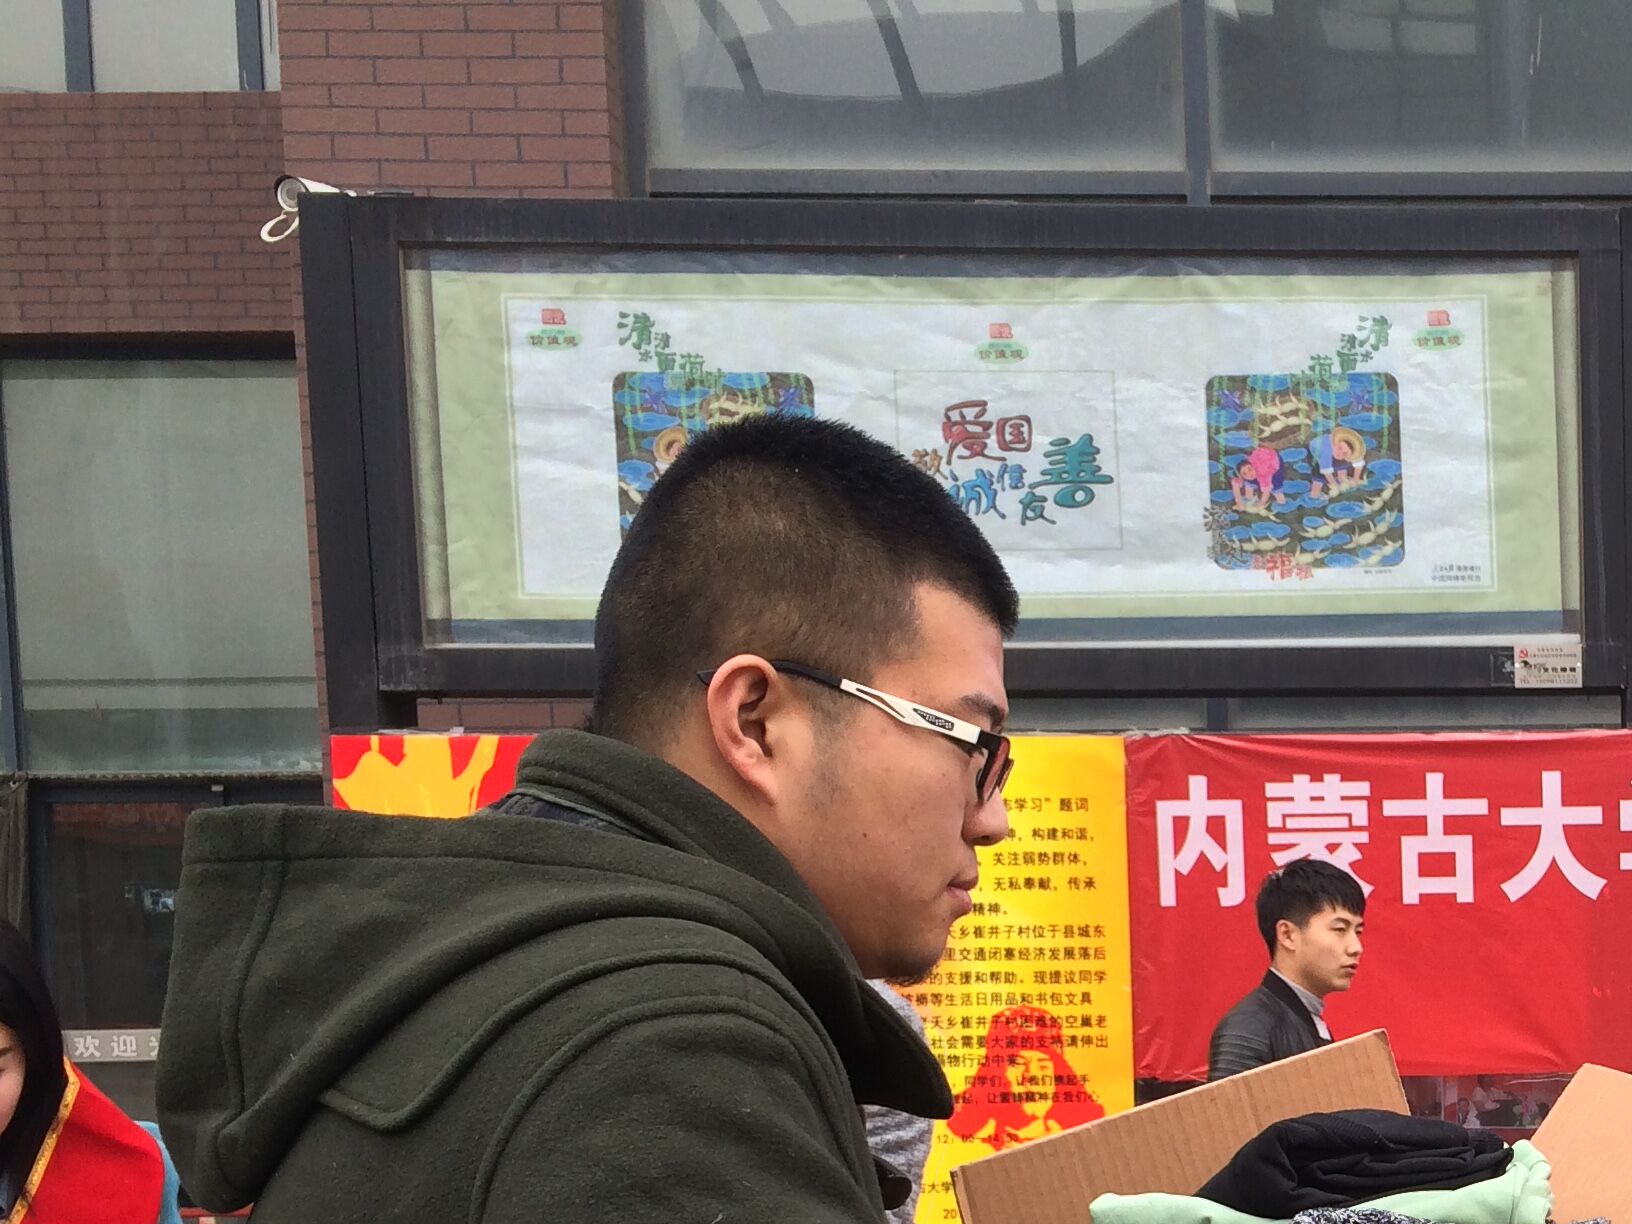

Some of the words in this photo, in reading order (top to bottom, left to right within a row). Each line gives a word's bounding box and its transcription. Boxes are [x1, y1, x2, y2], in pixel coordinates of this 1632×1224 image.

[942, 400, 1032, 465] 爱国
[949, 463, 1027, 520] 诚信
[925, 969, 1107, 986] 的支援和帮助。现提议同学
